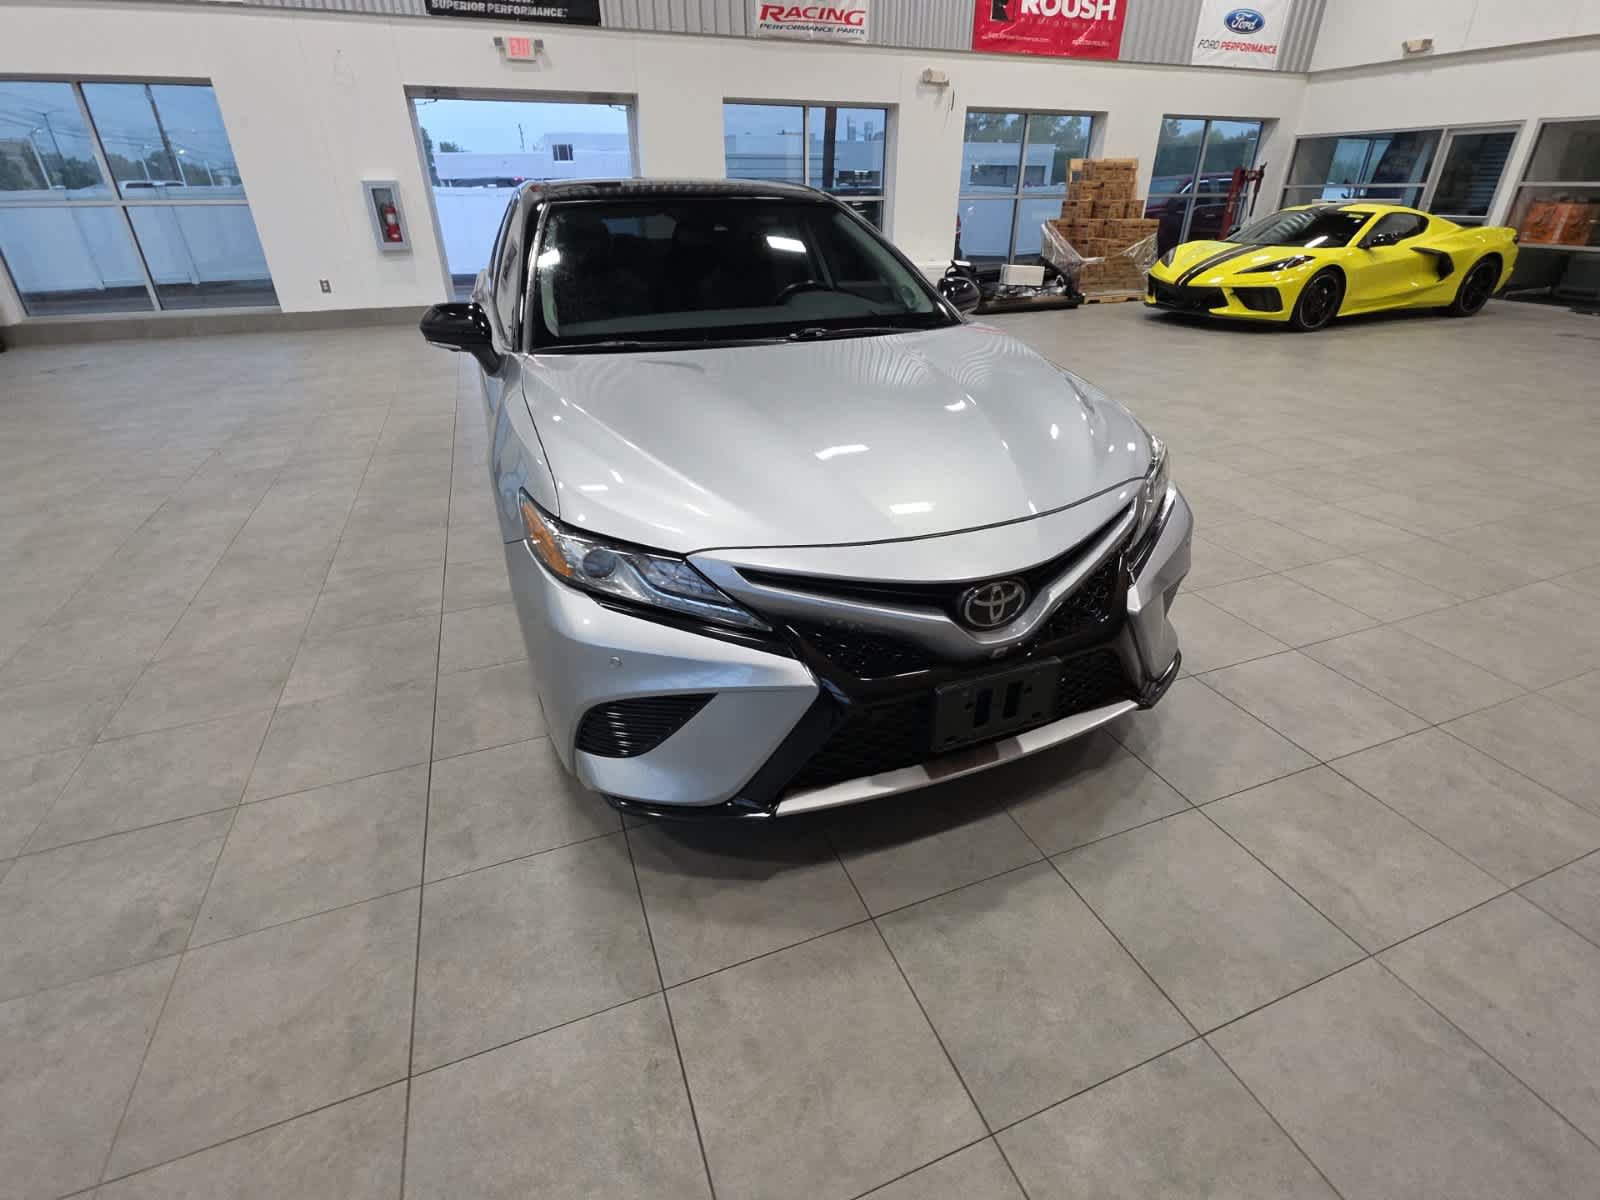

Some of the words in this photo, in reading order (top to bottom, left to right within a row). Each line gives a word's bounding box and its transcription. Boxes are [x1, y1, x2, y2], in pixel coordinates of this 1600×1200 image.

[431, 0, 486, 12] SUPERIOR
[759, 4, 866, 26] RACING
[1231, 12, 1258, 30] Ford
[759, 23, 834, 33] PERFORMANCE
[836, 27, 865, 35] PARTS
[1197, 39, 1220, 50] FORD
[1220, 41, 1278, 55] PERFORMANCE
